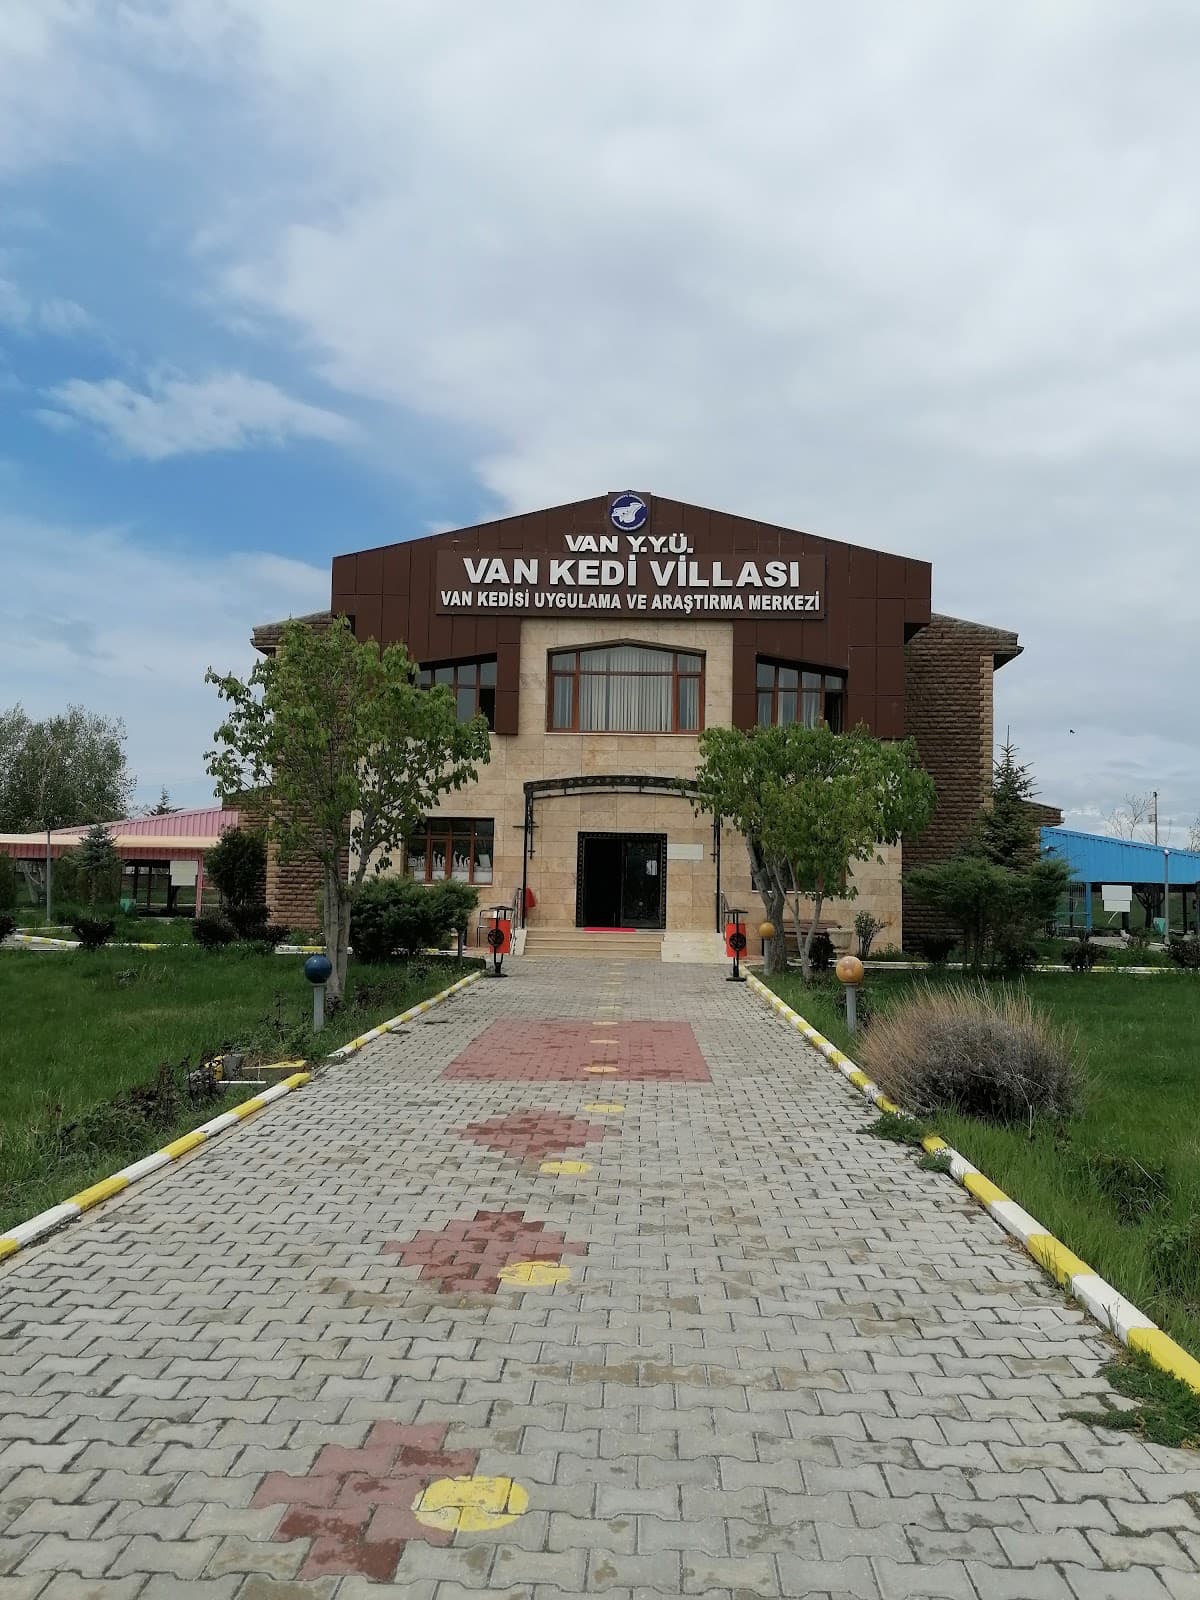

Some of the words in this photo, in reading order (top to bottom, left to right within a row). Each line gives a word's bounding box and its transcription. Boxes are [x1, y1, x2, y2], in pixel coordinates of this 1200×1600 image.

[565, 535, 618, 552] VAN
[626, 533, 694, 553] Y.Y.Ü.
[463, 558, 538, 584] VAN
[550, 555, 636, 585] KEDİ
[650, 555, 799, 587] VİLLASI
[441, 591, 472, 605] VAN
[478, 589, 529, 607] KEDİSİ
[535, 593, 621, 608] UYGULAMA
[627, 594, 647, 609] VE
[652, 595, 743, 614] ARAŞTIRMA
[749, 591, 819, 610] MERKEZİ
